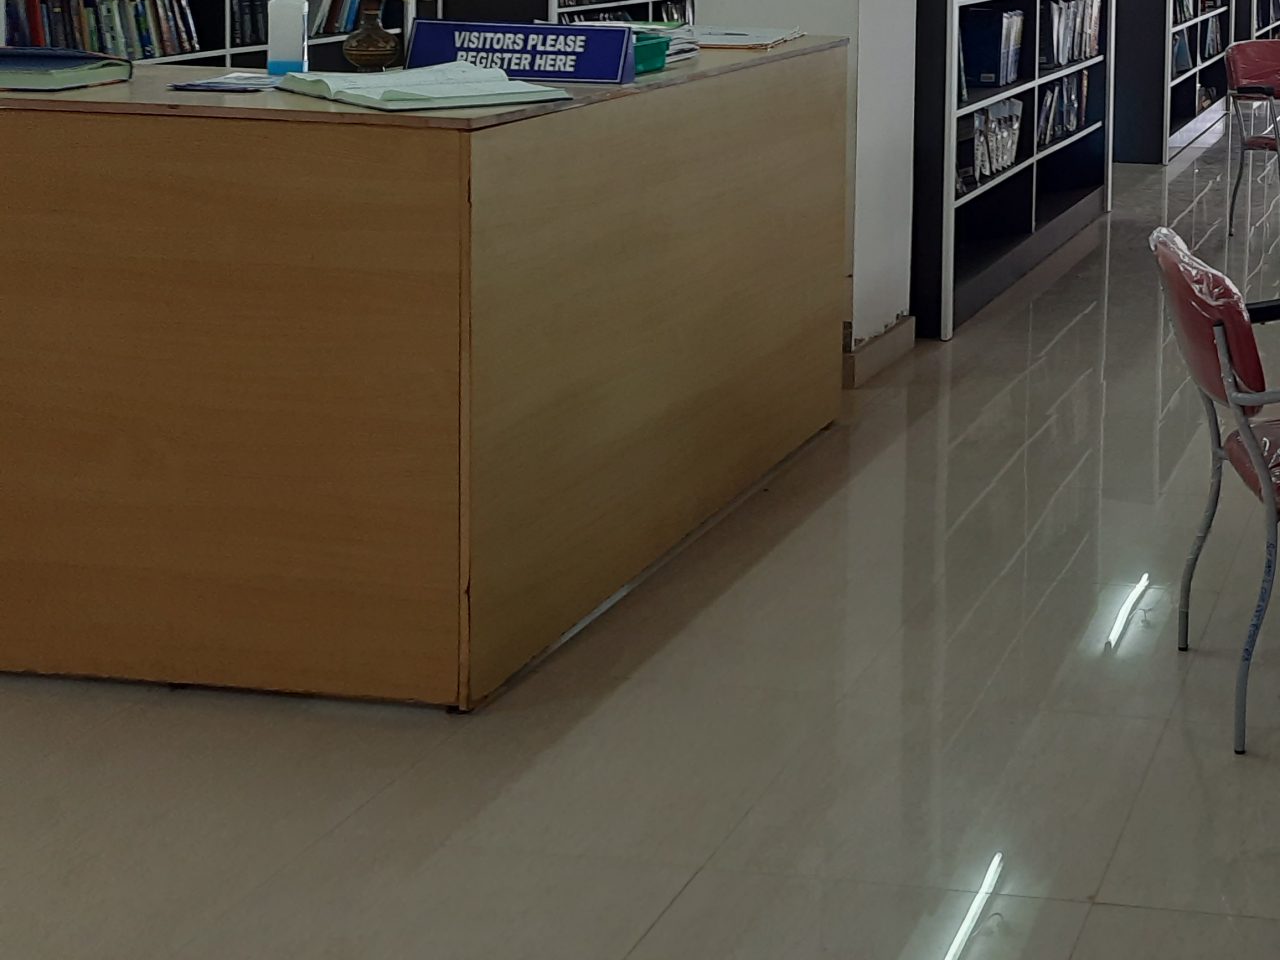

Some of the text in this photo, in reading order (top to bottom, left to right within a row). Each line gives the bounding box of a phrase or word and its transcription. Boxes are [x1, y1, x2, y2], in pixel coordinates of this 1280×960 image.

[454, 31, 586, 52] VISITORS PLEASE
[456, 51, 577, 72] REGISTER HERE
